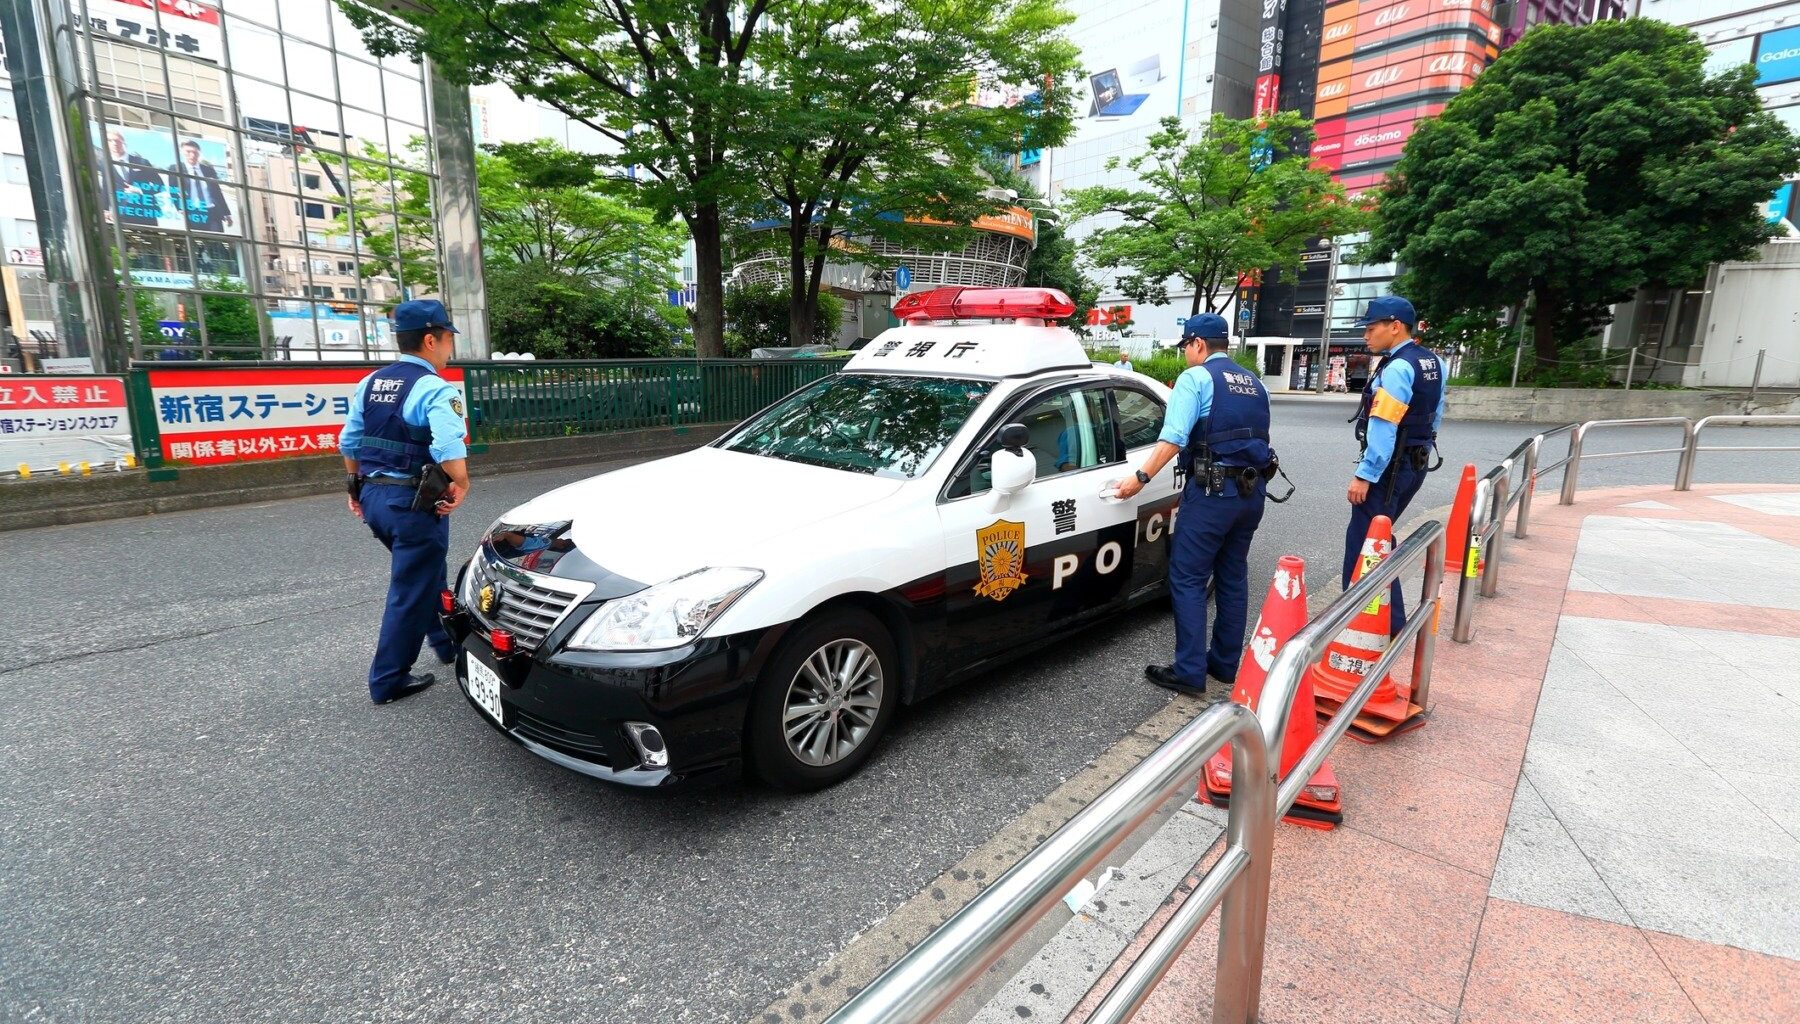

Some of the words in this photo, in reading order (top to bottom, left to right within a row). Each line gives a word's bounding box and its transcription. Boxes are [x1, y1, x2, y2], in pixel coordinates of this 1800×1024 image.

[1375, 4, 1410, 25] au
[1325, 24, 1352, 40] au
[1429, 55, 1468, 73] au
[1365, 65, 1404, 88] au
[1319, 82, 1346, 98] au
[1354, 130, 1402, 147] docomo
[1313, 142, 1341, 153] docomo
[131, 181, 188, 196] AOYAM
[873, 340, 980, 359] 警視庁
[371, 378, 405, 392] 警視庁
[1228, 384, 1258, 396] POLICE
[0, 384, 110, 404] 立入禁止
[369, 393, 398, 404] POLICE
[170, 432, 341, 461] 関係者以外立入禁
[982, 529, 1021, 546] POLICE
